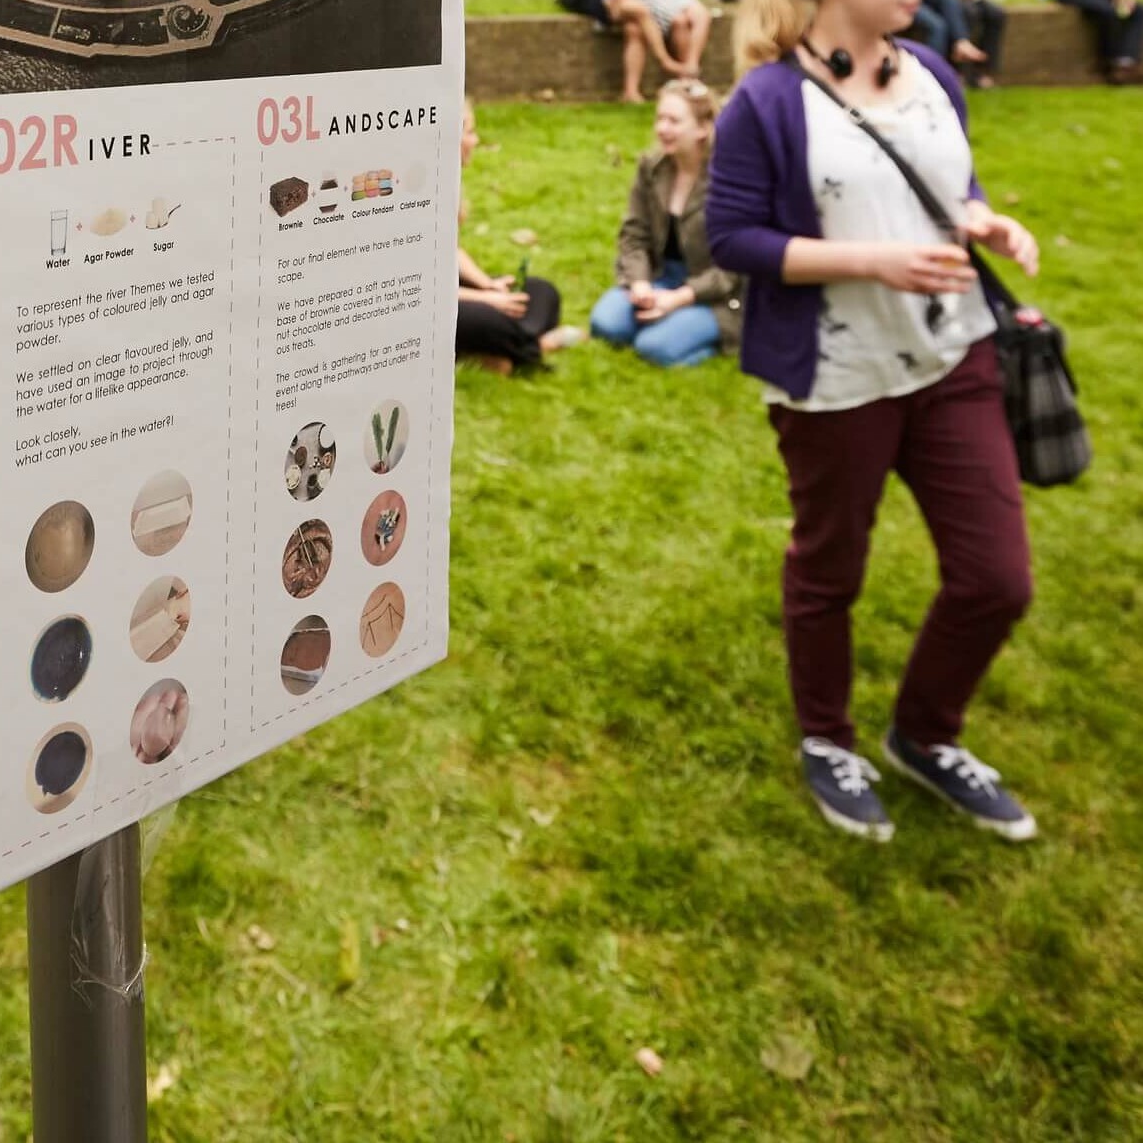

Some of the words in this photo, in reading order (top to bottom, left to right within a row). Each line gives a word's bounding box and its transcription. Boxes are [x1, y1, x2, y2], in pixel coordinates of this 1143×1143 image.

[313, 213, 344, 225] Chocolate
[352, 210, 371, 218] Colour
[279, 220, 303, 231] Brownie
[154, 242, 174, 252] Sugar
[84, 254, 103, 264] Agar
[106, 248, 134, 259] Powder
[46, 258, 70, 269] Water
[17, 306, 29, 317] To
[33, 295, 82, 319] represent
[86, 293, 102, 305] the
[106, 289, 127, 302] river
[130, 280, 166, 296] Themes
[168, 279, 183, 290] we
[186, 270, 214, 287] tested
[17, 317, 54, 334] various
[58, 310, 85, 328] types
[88, 306, 100, 320] of
[103, 297, 147, 317] coloured
[149, 293, 167, 311] jelly
[170, 288, 190, 303] and
[192, 287, 214, 300] agar
[15, 448, 43, 467] what
[45, 446, 67, 459] can
[69, 440, 88, 456] you
[90, 436, 108, 448] see
[110, 432, 118, 442] in
[121, 425, 136, 439] the
[16, 435, 41, 451] Look
